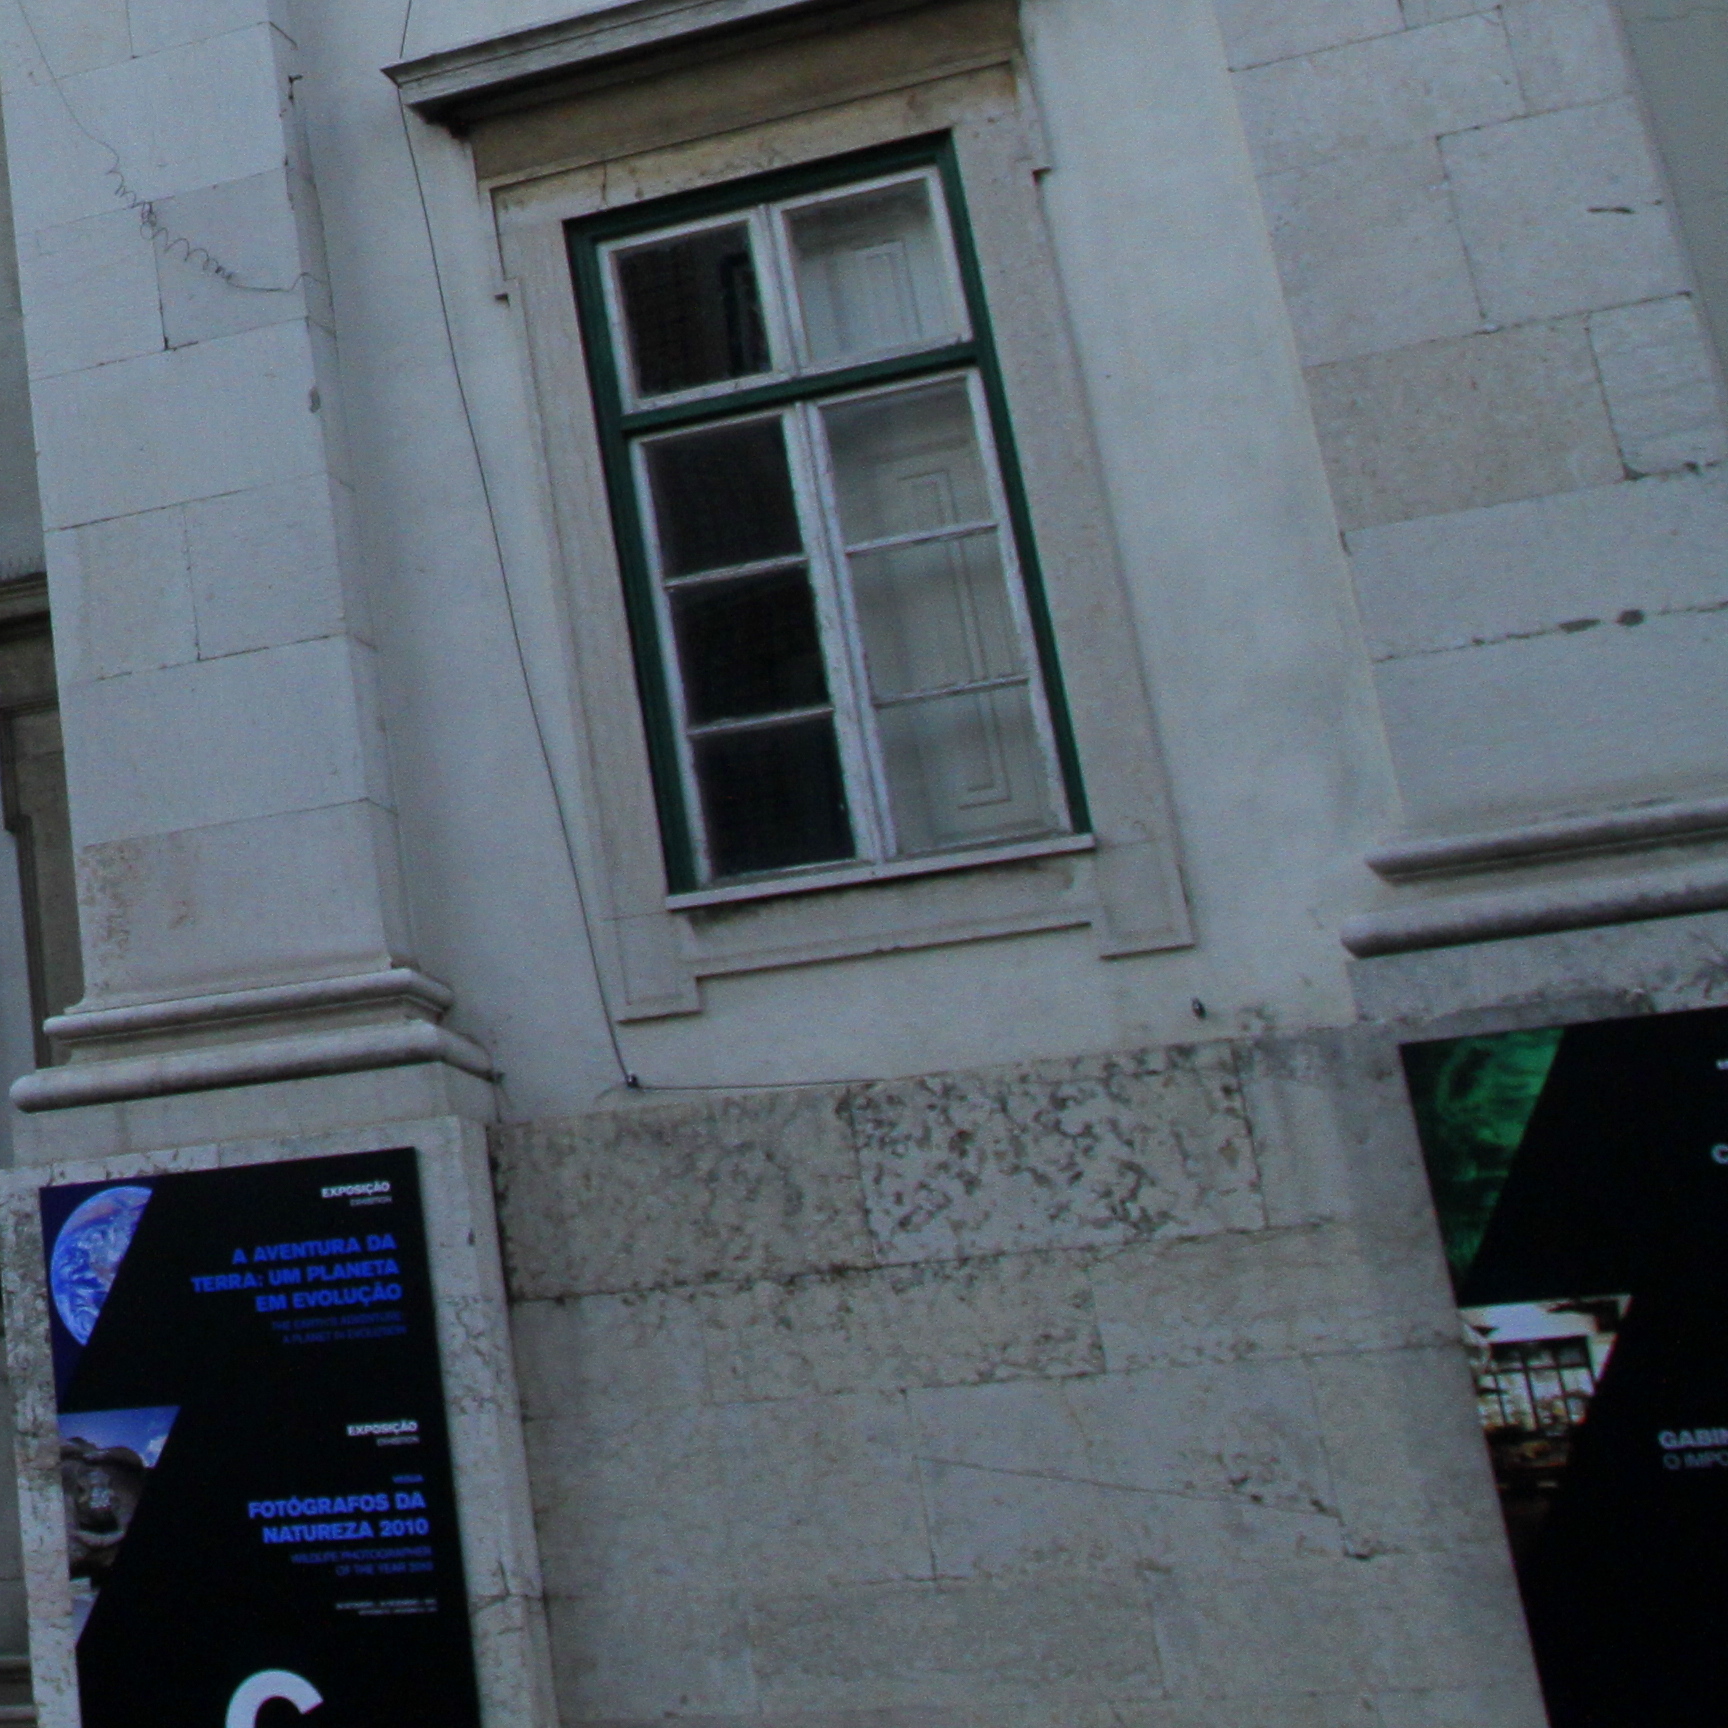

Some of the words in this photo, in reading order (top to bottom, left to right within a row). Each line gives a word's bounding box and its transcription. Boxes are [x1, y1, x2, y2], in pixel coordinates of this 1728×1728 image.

[321, 1179, 392, 1199] EXPOSIÇÃO
[231, 1248, 249, 1265] A
[252, 1237, 362, 1262] AVENTURA
[365, 1233, 397, 1252] DA
[190, 1272, 264, 1293] TERRA:
[267, 1268, 301, 1286] UM
[306, 1258, 400, 1282] PLANETA
[254, 1294, 288, 1313] EM
[292, 1281, 404, 1308] EVOLUÇÃO
[346, 1419, 420, 1436] EXPOSIÇÃO
[248, 1495, 390, 1520] FOTÓGRAFOS
[394, 1490, 427, 1511] DA
[261, 1520, 375, 1544] NATUREZA
[378, 1516, 430, 1538] 2010
